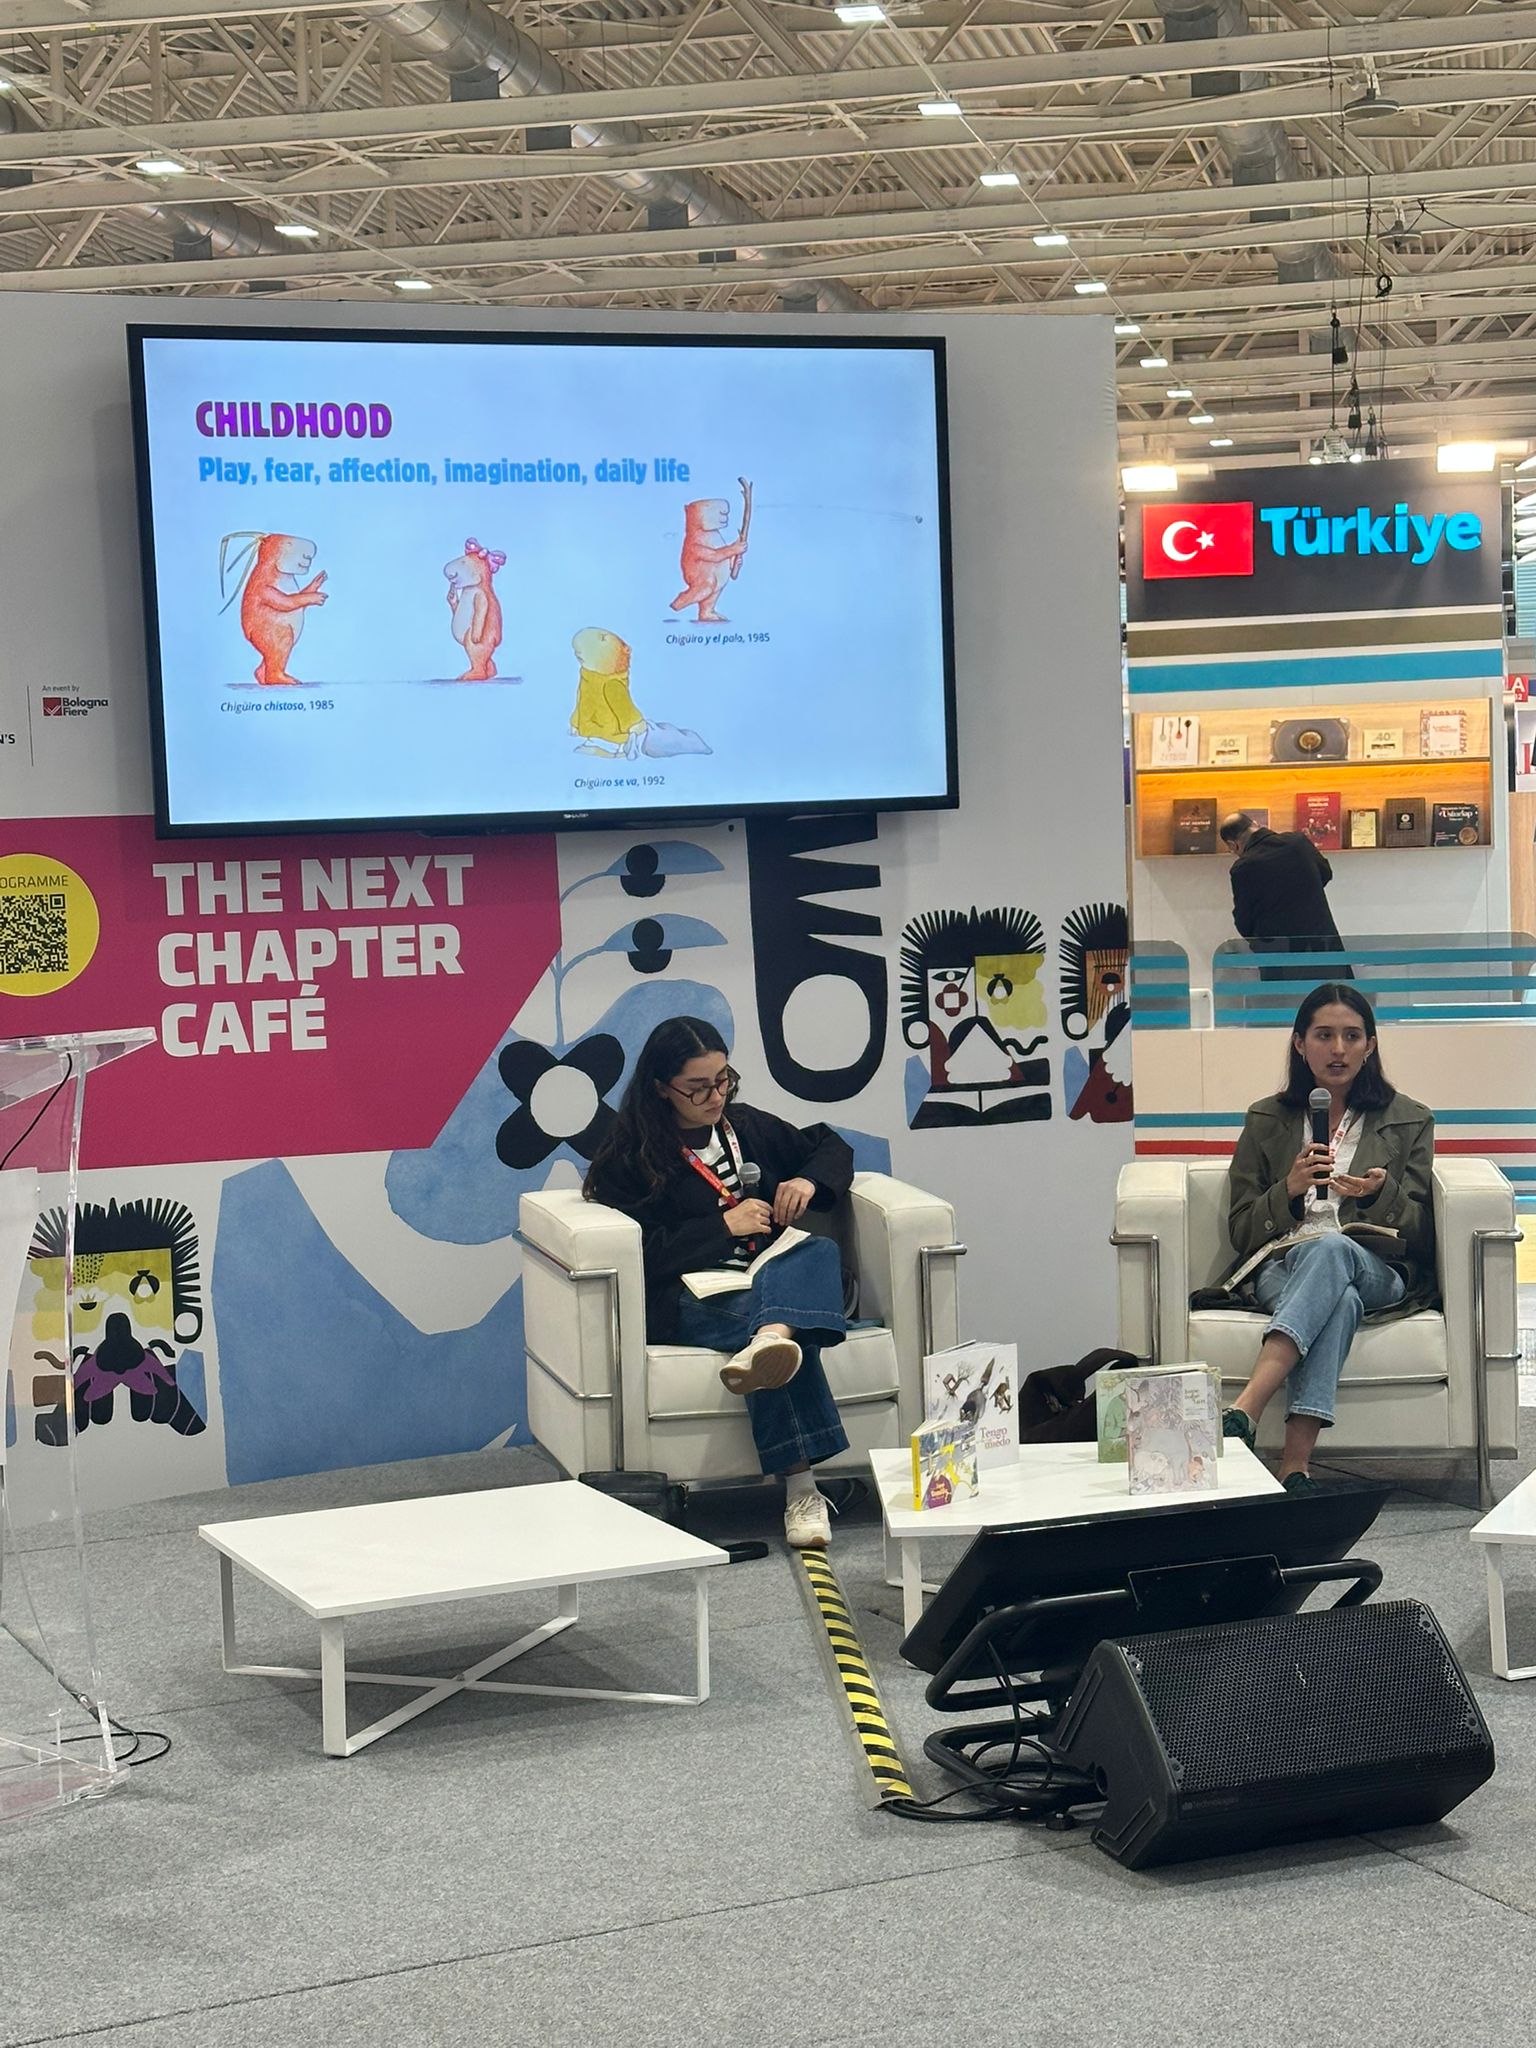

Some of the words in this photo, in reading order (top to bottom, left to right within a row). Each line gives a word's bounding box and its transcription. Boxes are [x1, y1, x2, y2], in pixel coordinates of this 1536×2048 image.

[196, 401, 392, 438] CHILDHOOD
[199, 456, 257, 485] Play,
[264, 457, 321, 485] fear,
[328, 457, 437, 485] affection,
[444, 458, 587, 485] imagination,
[595, 458, 647, 485] daily
[654, 458, 690, 482] life
[1260, 503, 1482, 565] Türkiye
[704, 635, 711, 645] y
[712, 634, 720, 643] el
[747, 632, 770, 642] 1985
[63, 697, 108, 709] Bologna
[63, 708, 88, 716] Fiere
[264, 701, 306, 712] chistoso,
[310, 700, 334, 710] 1985
[614, 779, 624, 787] se
[642, 776, 665, 786] 1992
[152, 860, 283, 916] THE
[301, 854, 474, 911] NEXT
[158, 923, 464, 987] CHAPTER
[161, 983, 327, 1057] CAFÉ
[980, 1427, 1007, 1440] Tengo
